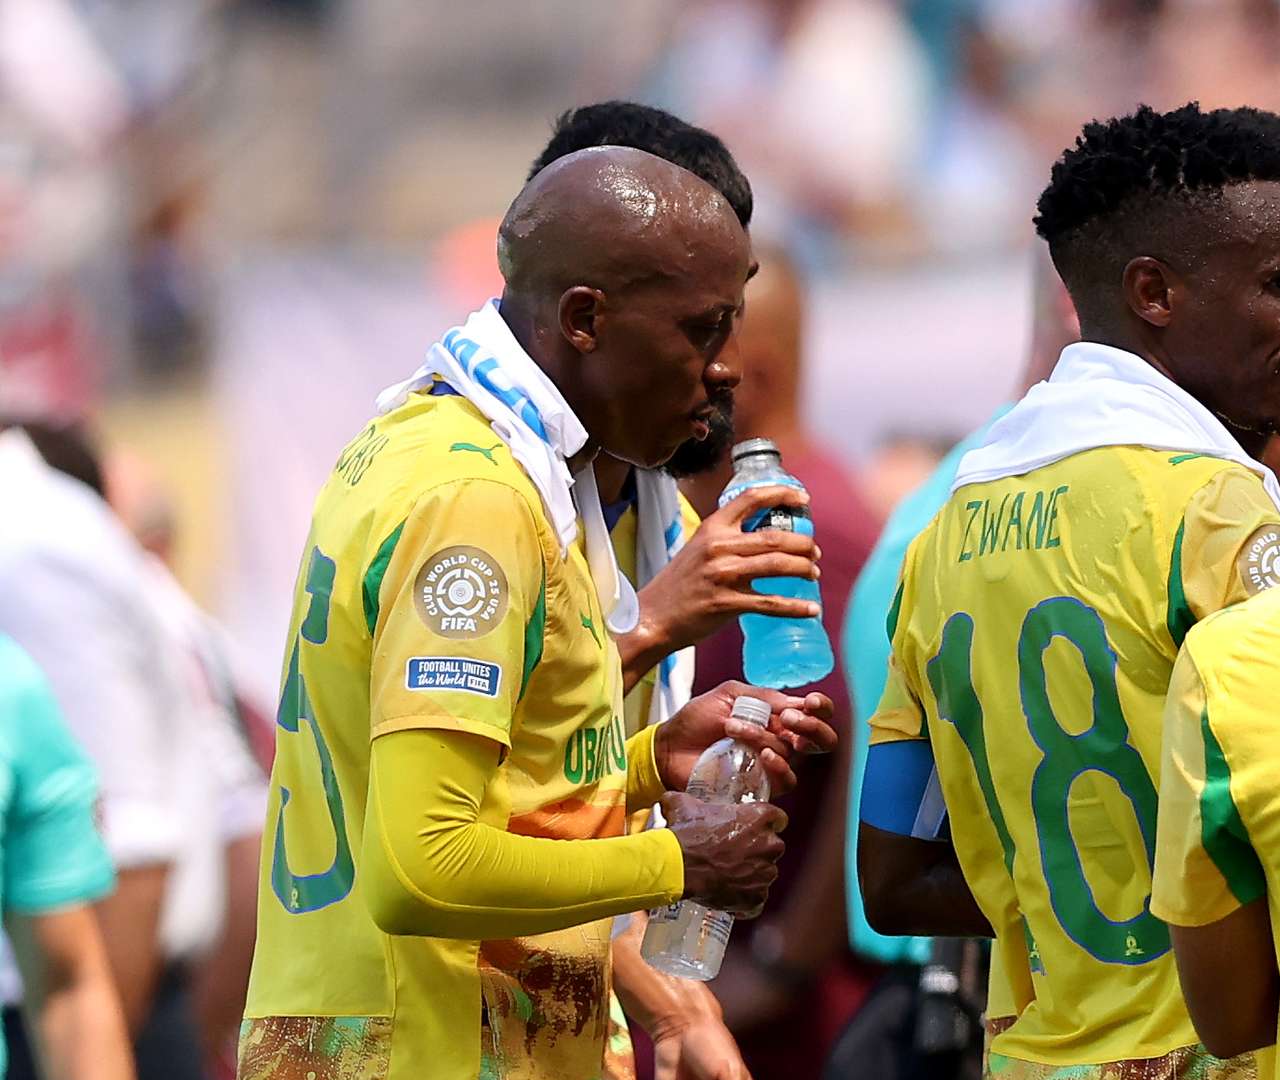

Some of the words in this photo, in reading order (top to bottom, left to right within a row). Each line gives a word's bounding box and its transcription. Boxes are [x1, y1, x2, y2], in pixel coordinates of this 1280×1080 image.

[958, 485, 1070, 563] ZWANE
[1248, 533, 1277, 562] WORLD
[426, 555, 467, 583] WORLD
[470, 557, 494, 577] CUP
[488, 580, 500, 595] 25
[423, 586, 438, 616] CLUB
[480, 598, 500, 621] USA
[440, 617, 476, 632] FIFA
[416, 673, 435, 686] the
[434, 672, 468, 687] World
[418, 661, 461, 673] FOOTBALL
[462, 663, 492, 678] UNITES
[925, 595, 1173, 978] 18
